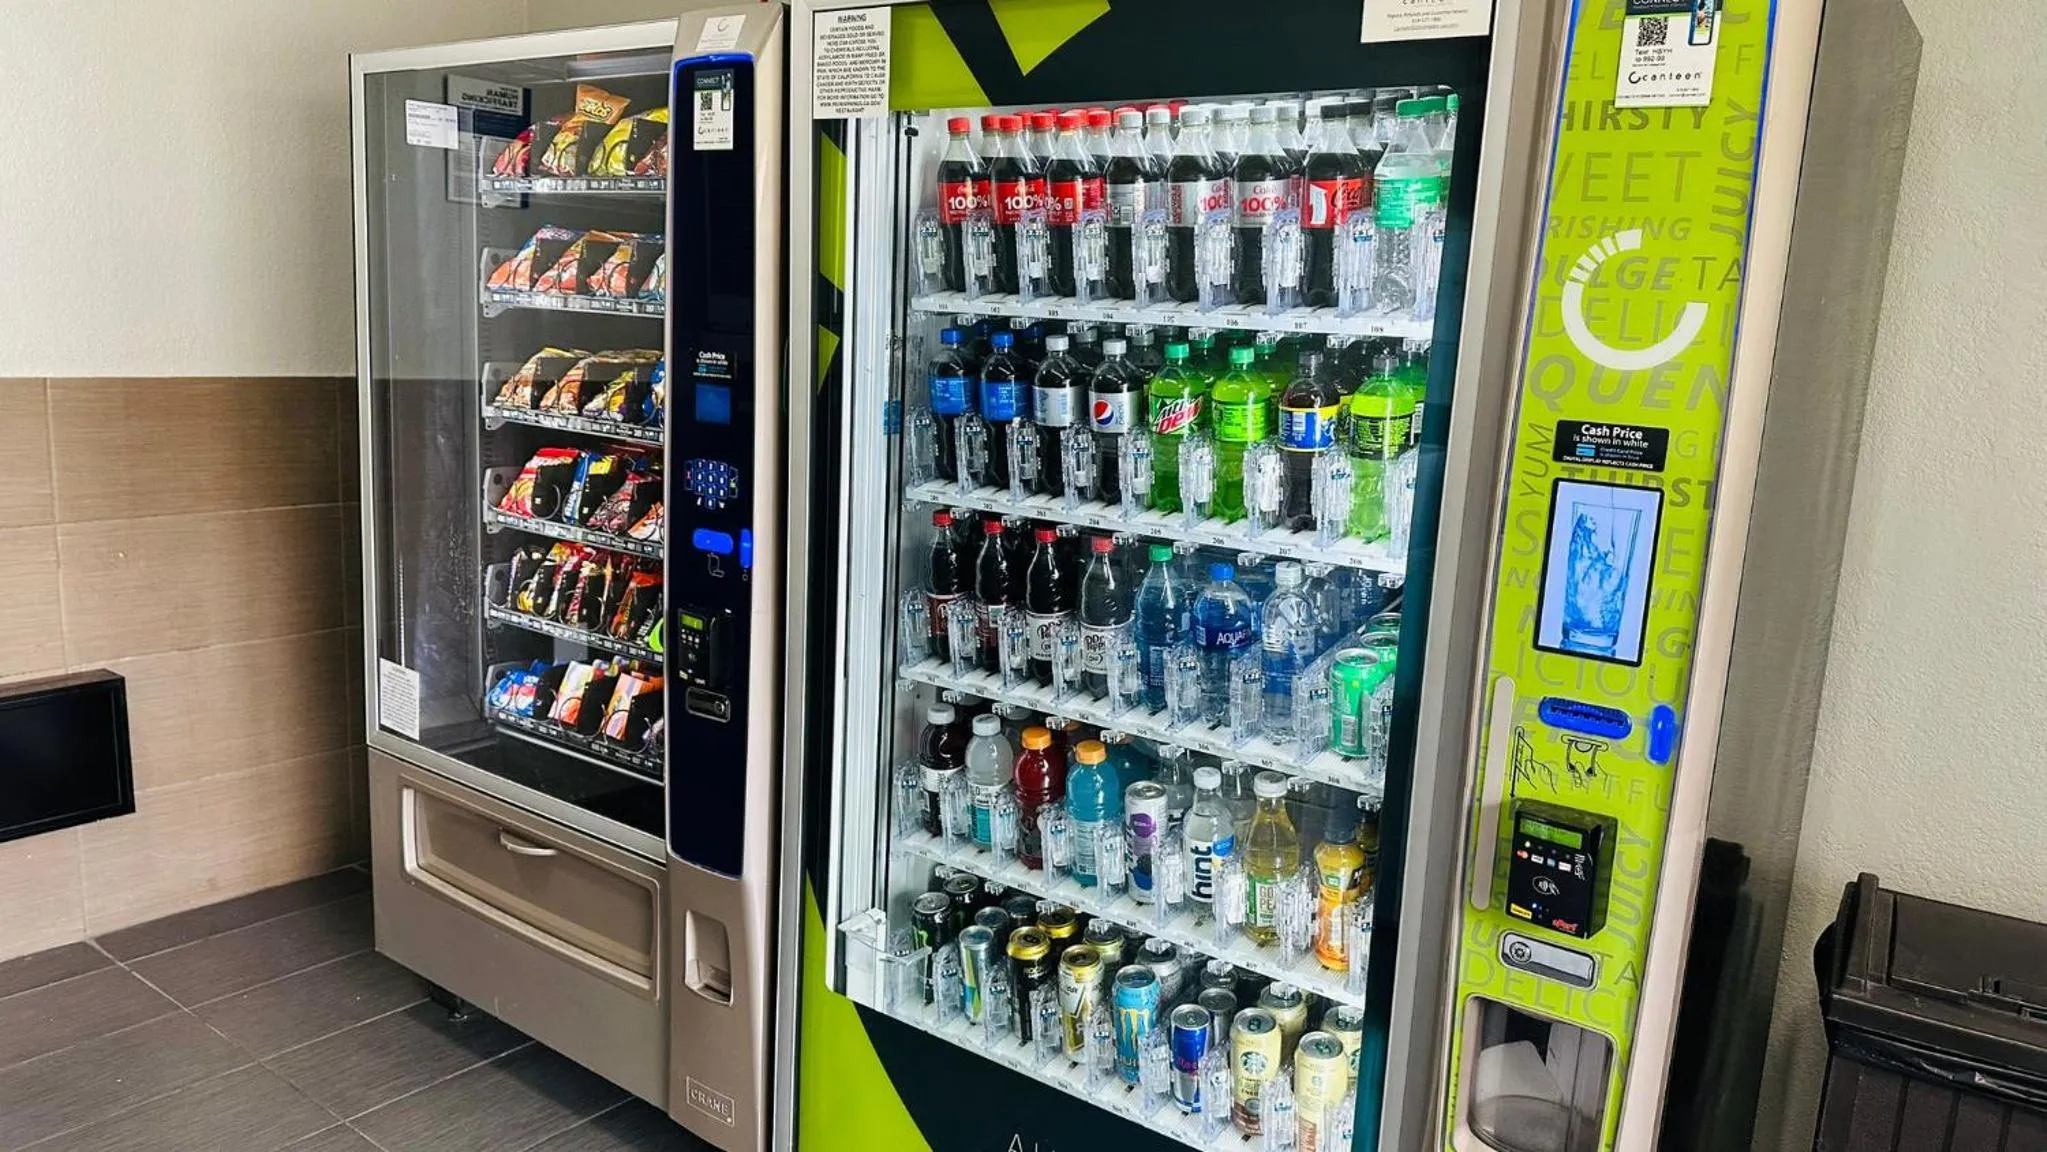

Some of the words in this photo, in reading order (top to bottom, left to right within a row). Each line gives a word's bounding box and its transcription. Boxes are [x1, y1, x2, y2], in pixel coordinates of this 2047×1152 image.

[838, 13, 866, 23] WARNING
[1642, 72, 1701, 81] canteen
[1581, 424, 1609, 437] Cash
[1613, 427, 1643, 439] Price
[1582, 435, 1611, 444] shown
[1612, 437, 1620, 445] in
[1623, 438, 1649, 449] white
[1519, 422, 1553, 498] YUM
[1191, 845, 1213, 899] hint
[691, 1088, 730, 1116] CRANE
